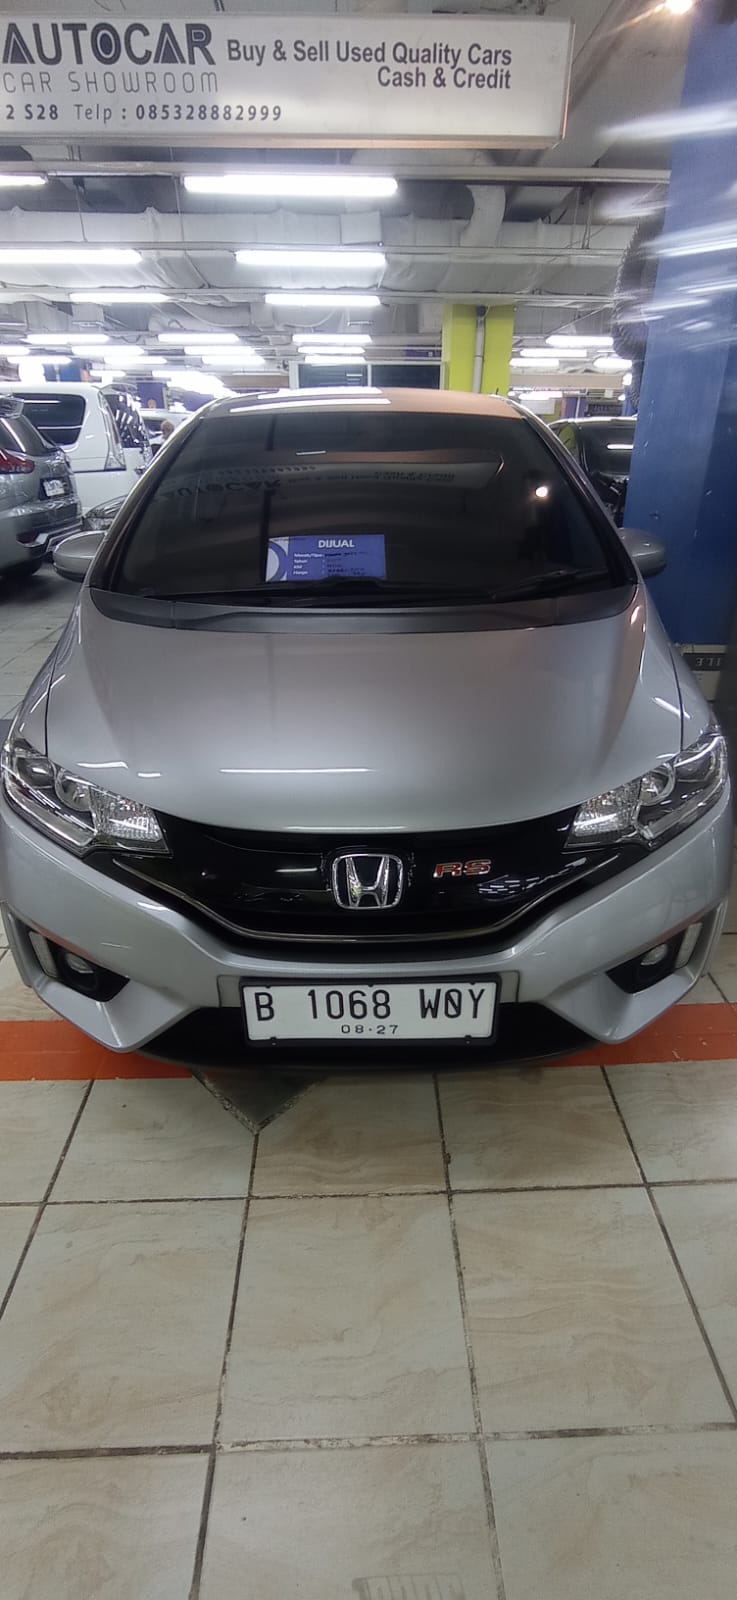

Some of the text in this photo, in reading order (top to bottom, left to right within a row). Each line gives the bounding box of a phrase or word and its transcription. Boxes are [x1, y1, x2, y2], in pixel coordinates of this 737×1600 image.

[3, 22, 217, 65] AUTOCAR
[227, 39, 512, 69] Buy & Sell Used Quality Cars
[3, 71, 219, 94] CAR SHOWROOM
[377, 66, 511, 89] Cash & Credit
[24, 104, 59, 120] S28
[74, 104, 112, 123] Telp
[136, 104, 282, 121] 085328882999
[318, 539, 355, 549] DIJUAL
[433, 859, 492, 878] RS
[254, 992, 275, 1021] B
[307, 989, 391, 1020] 1068
